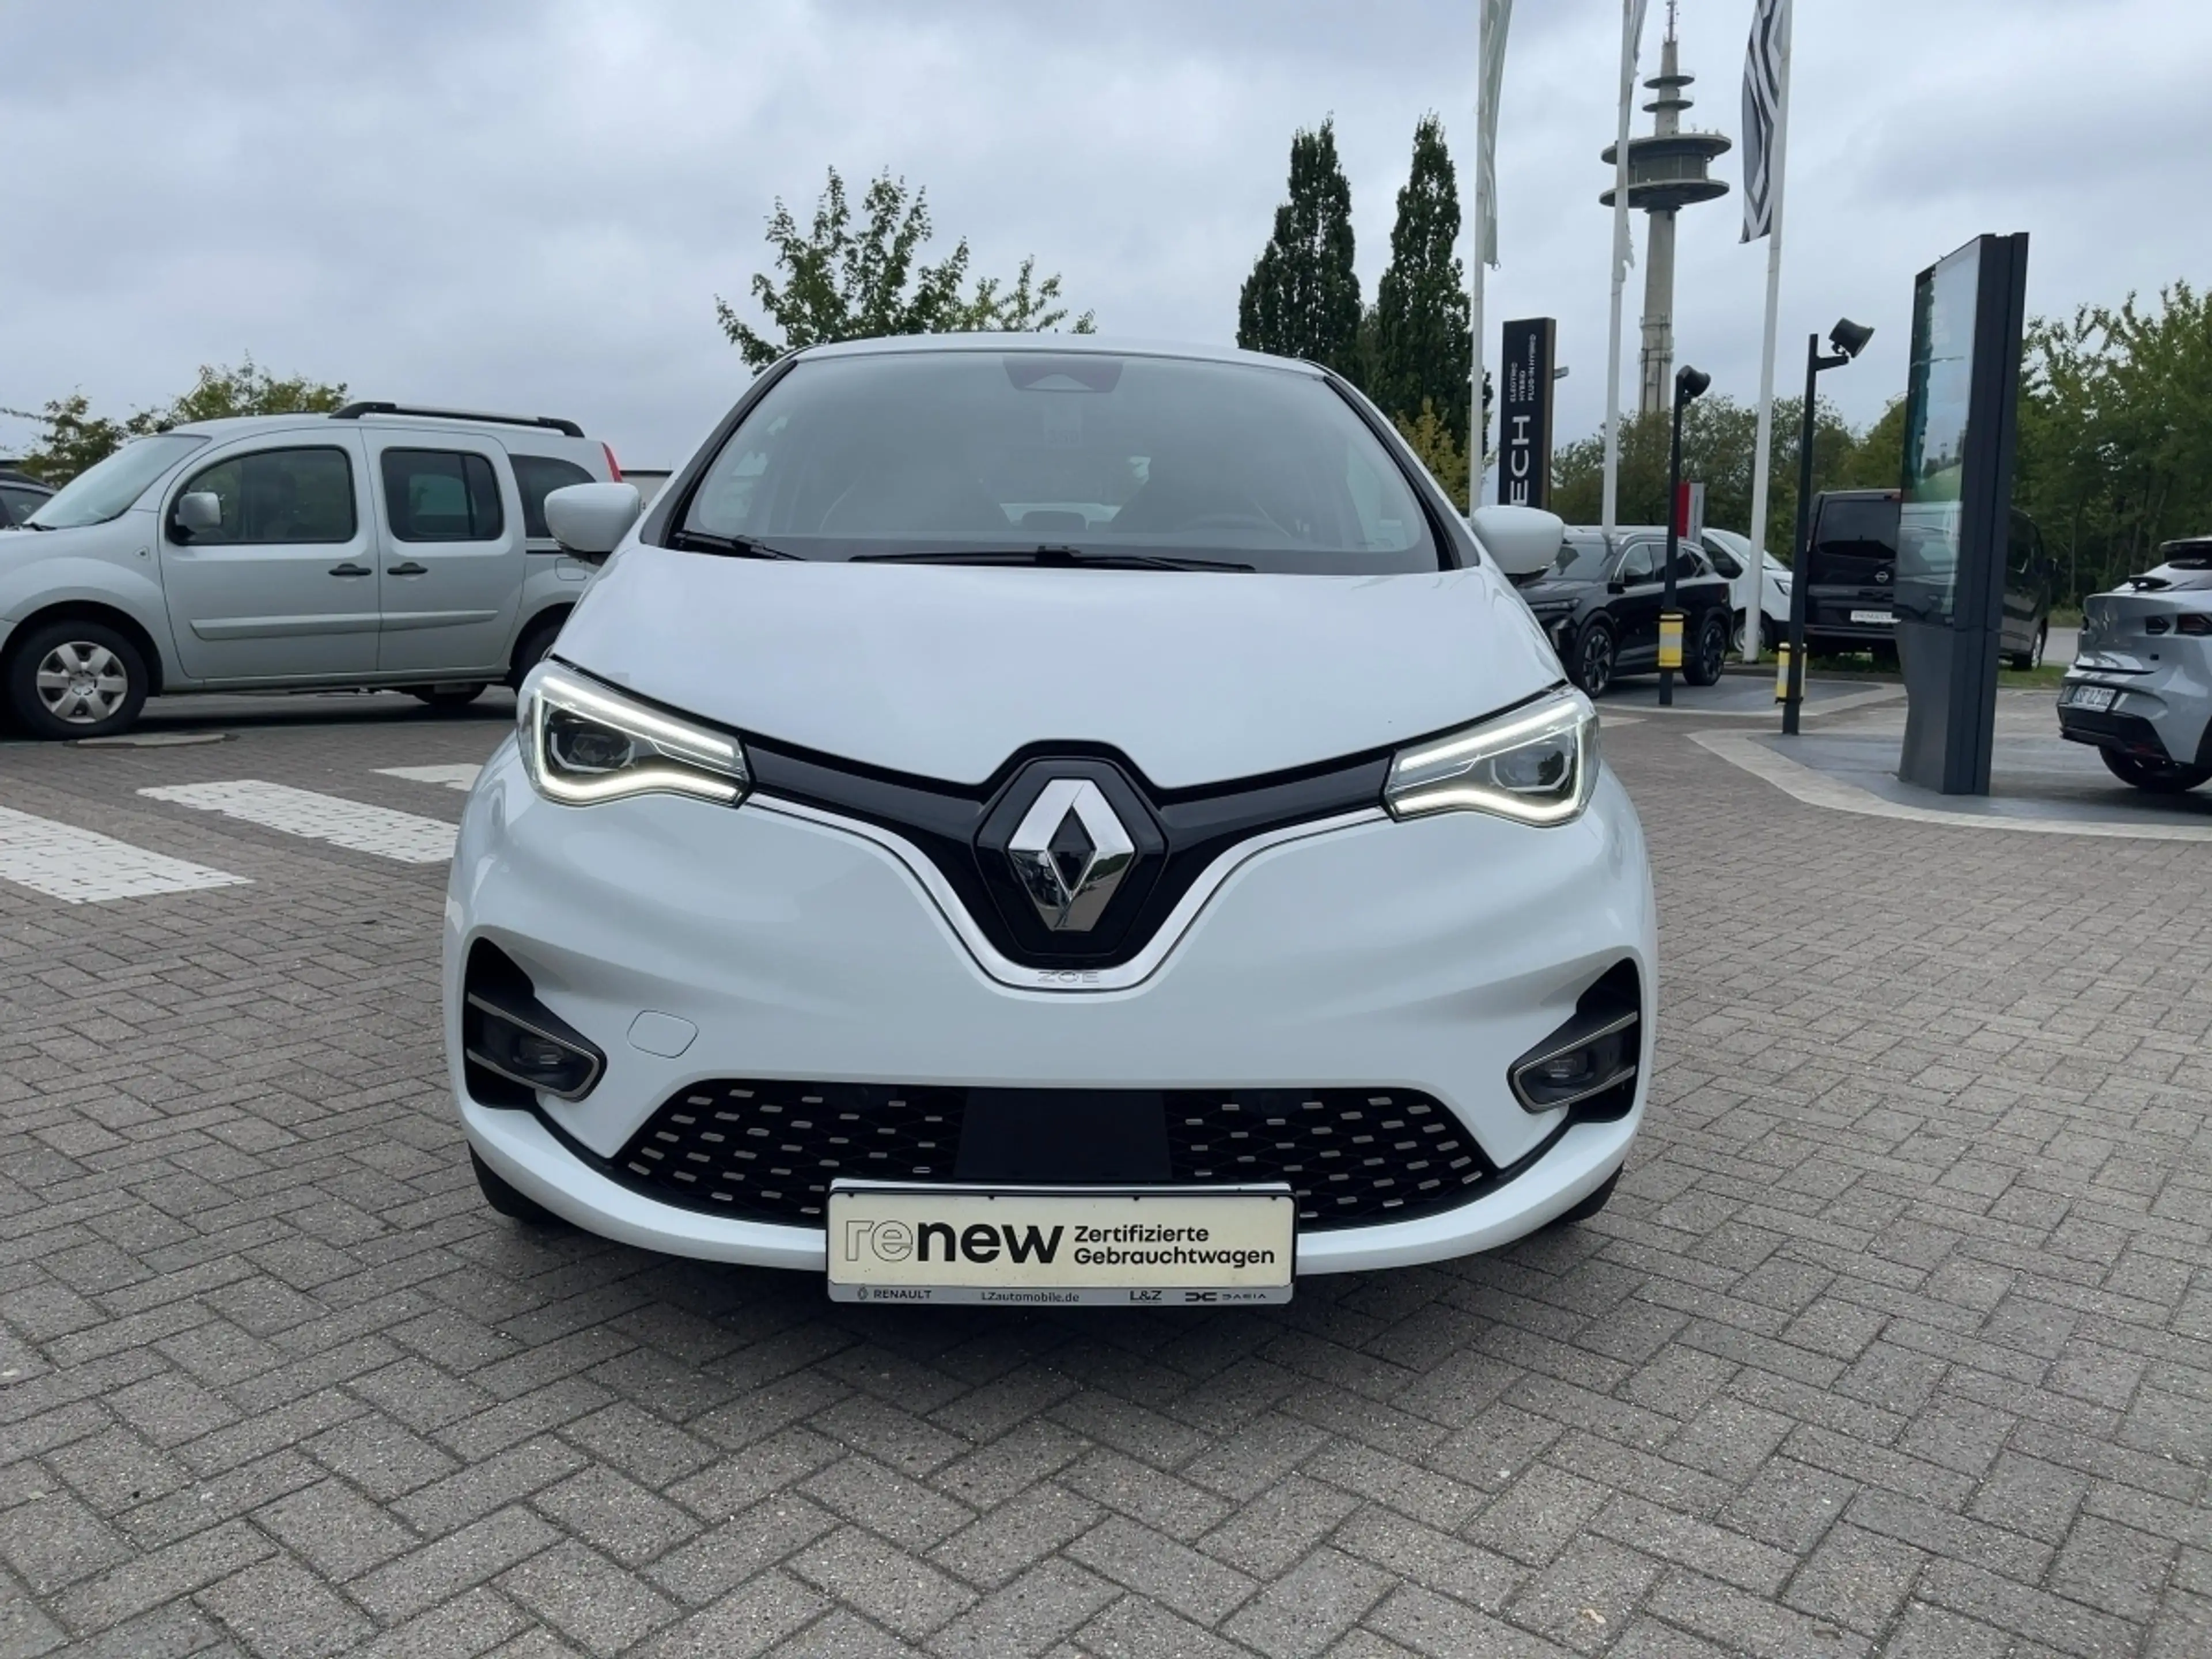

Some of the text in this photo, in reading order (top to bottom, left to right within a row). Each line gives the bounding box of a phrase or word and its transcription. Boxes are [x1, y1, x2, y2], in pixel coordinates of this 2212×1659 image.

[1529, 334, 1537, 366] HYBRID
[1037, 970, 1099, 983] ZOE
[846, 1220, 1065, 1263] renew
[1074, 1225, 1209, 1243] Zertifizierte
[1074, 1247, 1275, 1268] Gebrauchtwagen
[873, 1290, 931, 1300] RENAULT
[982, 1292, 1079, 1302] LZautomobile.de
[1130, 1290, 1162, 1301] L&Z
